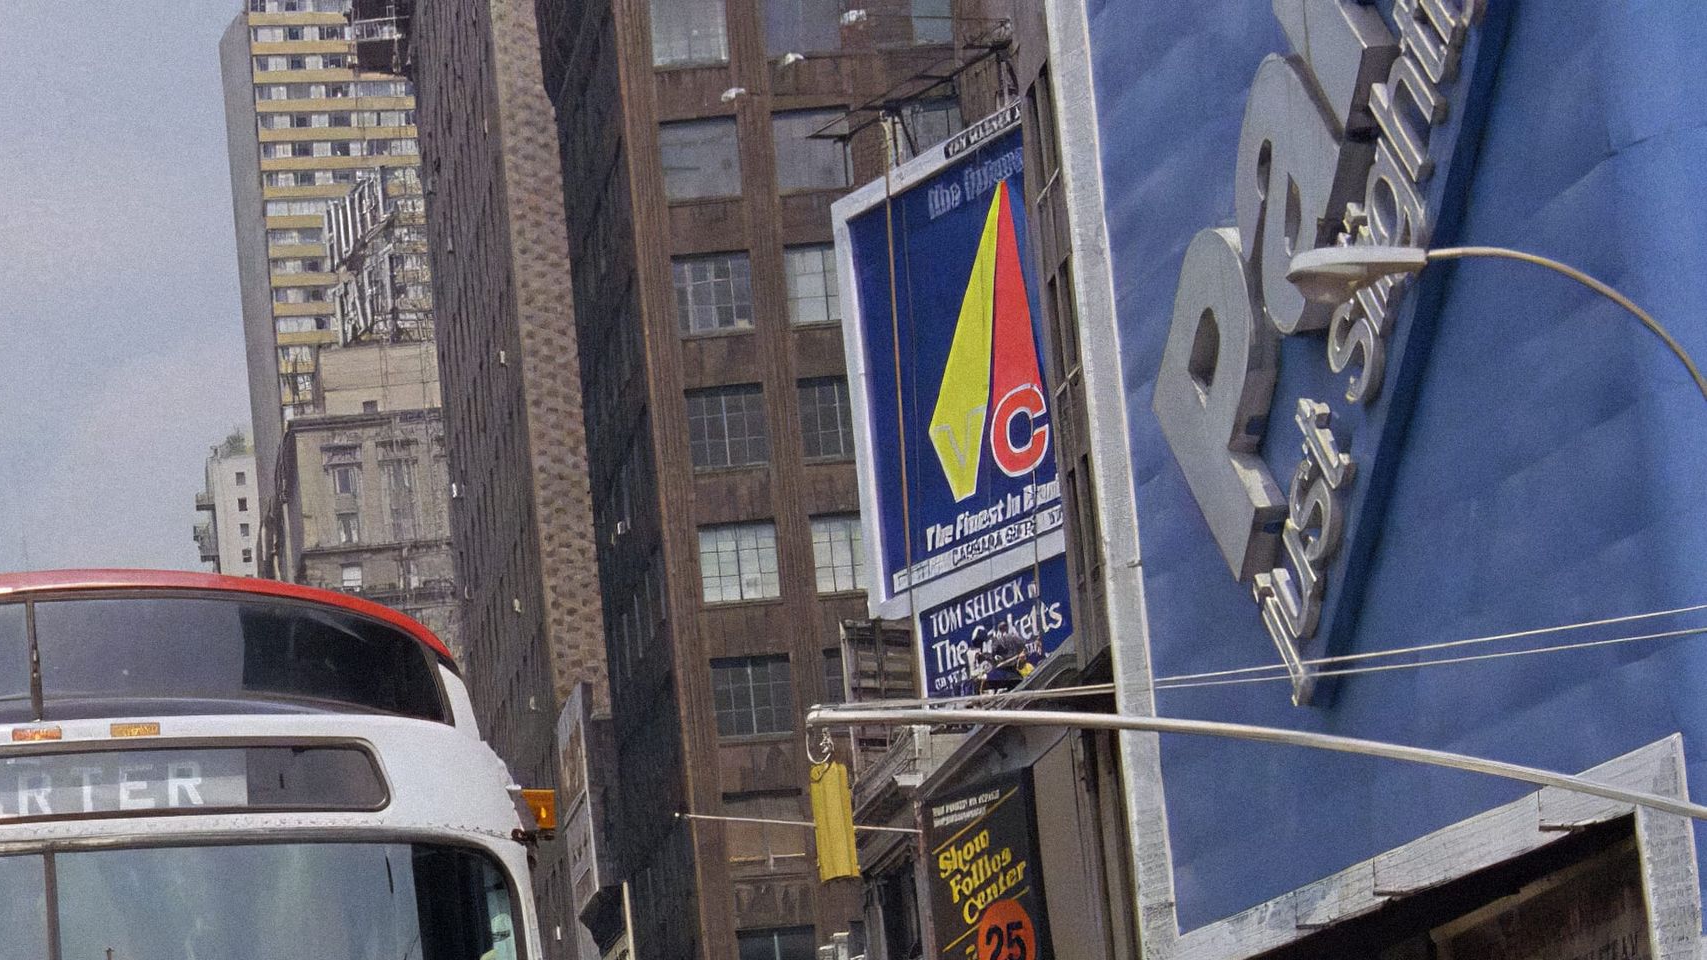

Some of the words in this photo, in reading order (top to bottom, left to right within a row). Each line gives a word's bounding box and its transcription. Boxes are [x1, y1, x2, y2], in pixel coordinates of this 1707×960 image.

[1153, 0, 1398, 582] Pa
[930, 604, 963, 638] TOM
[965, 577, 1031, 625] SELLECK
[932, 636, 969, 674] The
